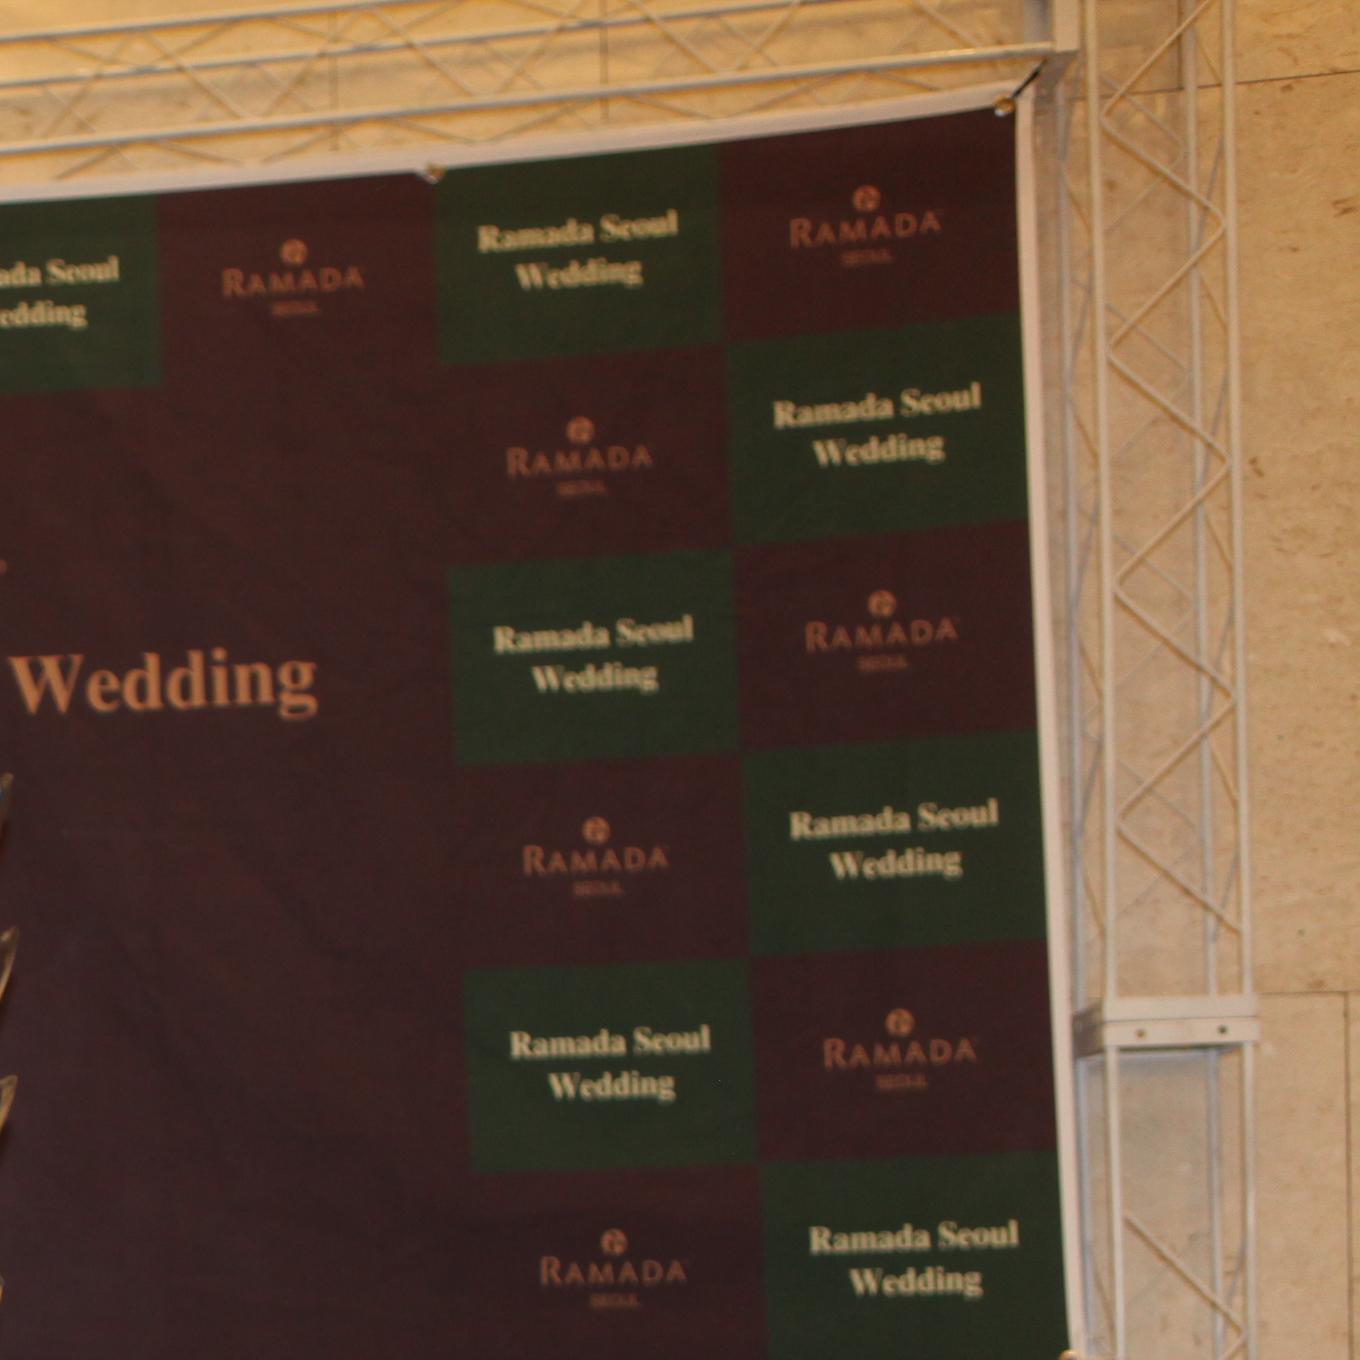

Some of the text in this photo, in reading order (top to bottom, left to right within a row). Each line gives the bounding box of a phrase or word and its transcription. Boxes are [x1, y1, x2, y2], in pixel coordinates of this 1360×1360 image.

[478, 210, 678, 252] Ramada Seoul
[790, 211, 940, 247] RAMADA
[47, 256, 119, 283] Seoul
[222, 267, 363, 296] RAMADA
[516, 258, 643, 288] Wedding
[774, 382, 981, 428] Ramada Seoul
[507, 446, 652, 477] RAMADA
[813, 434, 945, 465] Wedding
[494, 615, 693, 653] Ramada Seoul
[806, 618, 957, 651] RAMADA
[9, 648, 317, 718] Wedding
[532, 663, 658, 692] Wedding
[791, 798, 998, 839] Ramada Seoul
[523, 845, 668, 874] RAMADA
[830, 848, 962, 878] Wedding
[511, 1025, 710, 1058] Ramada Seoul
[824, 1038, 976, 1068] RAMADA
[549, 1071, 675, 1101] Wedding
[810, 1220, 1019, 1254] Ramada Seoul
[540, 1256, 686, 1285] RAMADA
[850, 1267, 983, 1298] Wedding
